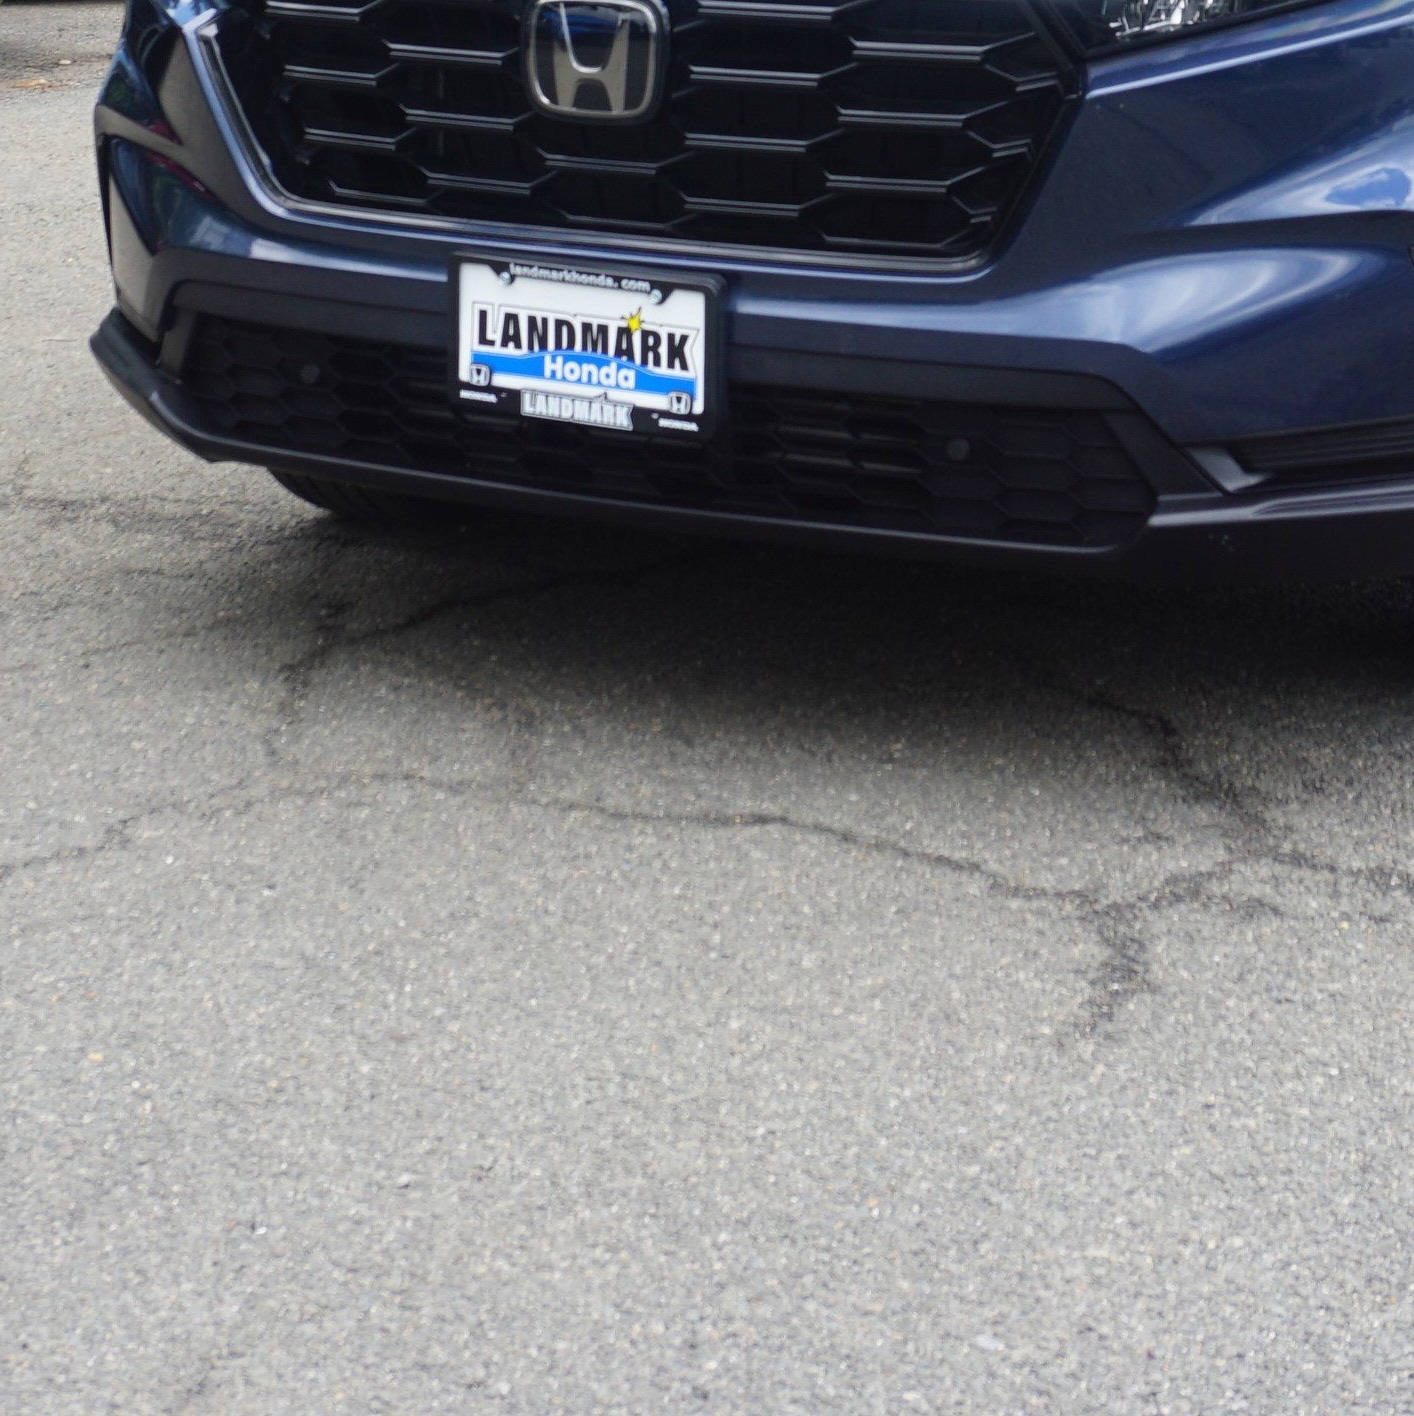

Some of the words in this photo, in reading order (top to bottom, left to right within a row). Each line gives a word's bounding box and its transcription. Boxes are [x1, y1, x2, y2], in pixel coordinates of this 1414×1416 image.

[478, 309, 689, 372] LANDMARK
[543, 355, 636, 390] Honda
[524, 392, 632, 429] LANDMARK
